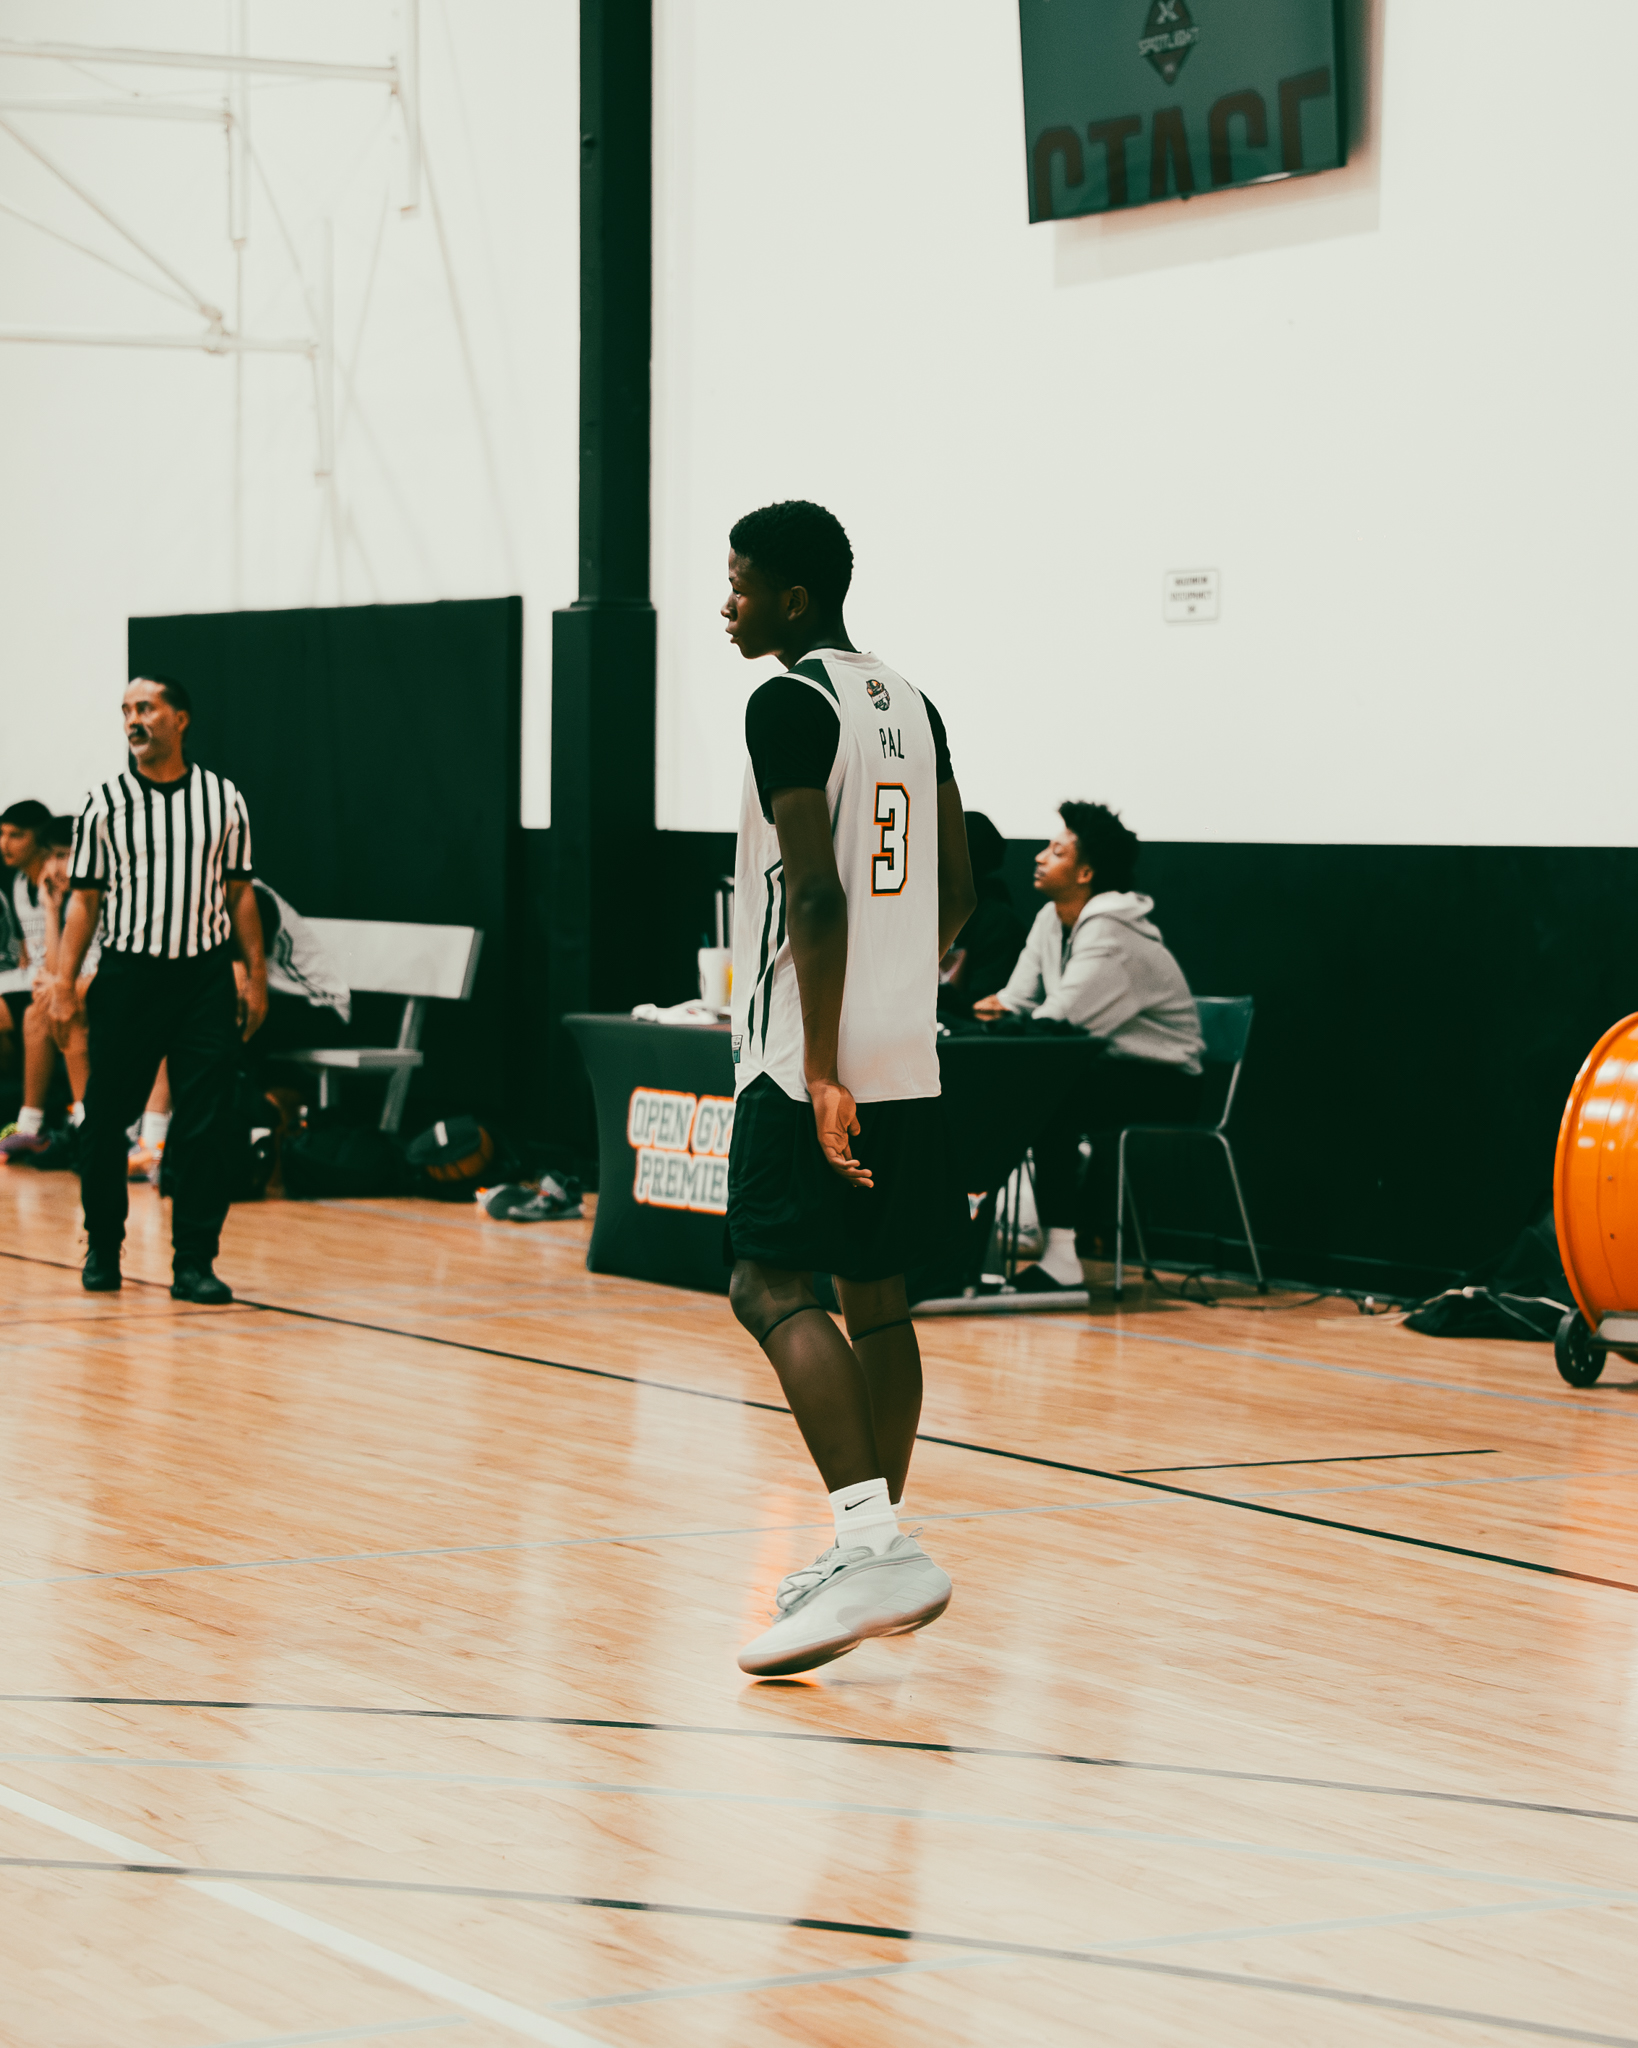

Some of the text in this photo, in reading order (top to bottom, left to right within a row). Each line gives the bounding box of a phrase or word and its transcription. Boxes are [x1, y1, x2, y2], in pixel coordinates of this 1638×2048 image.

[879, 727, 905, 759] PAL
[871, 782, 910, 897] 3
[632, 1097, 735, 1150] OPEN GY
[639, 1154, 727, 1205] PREMIE
